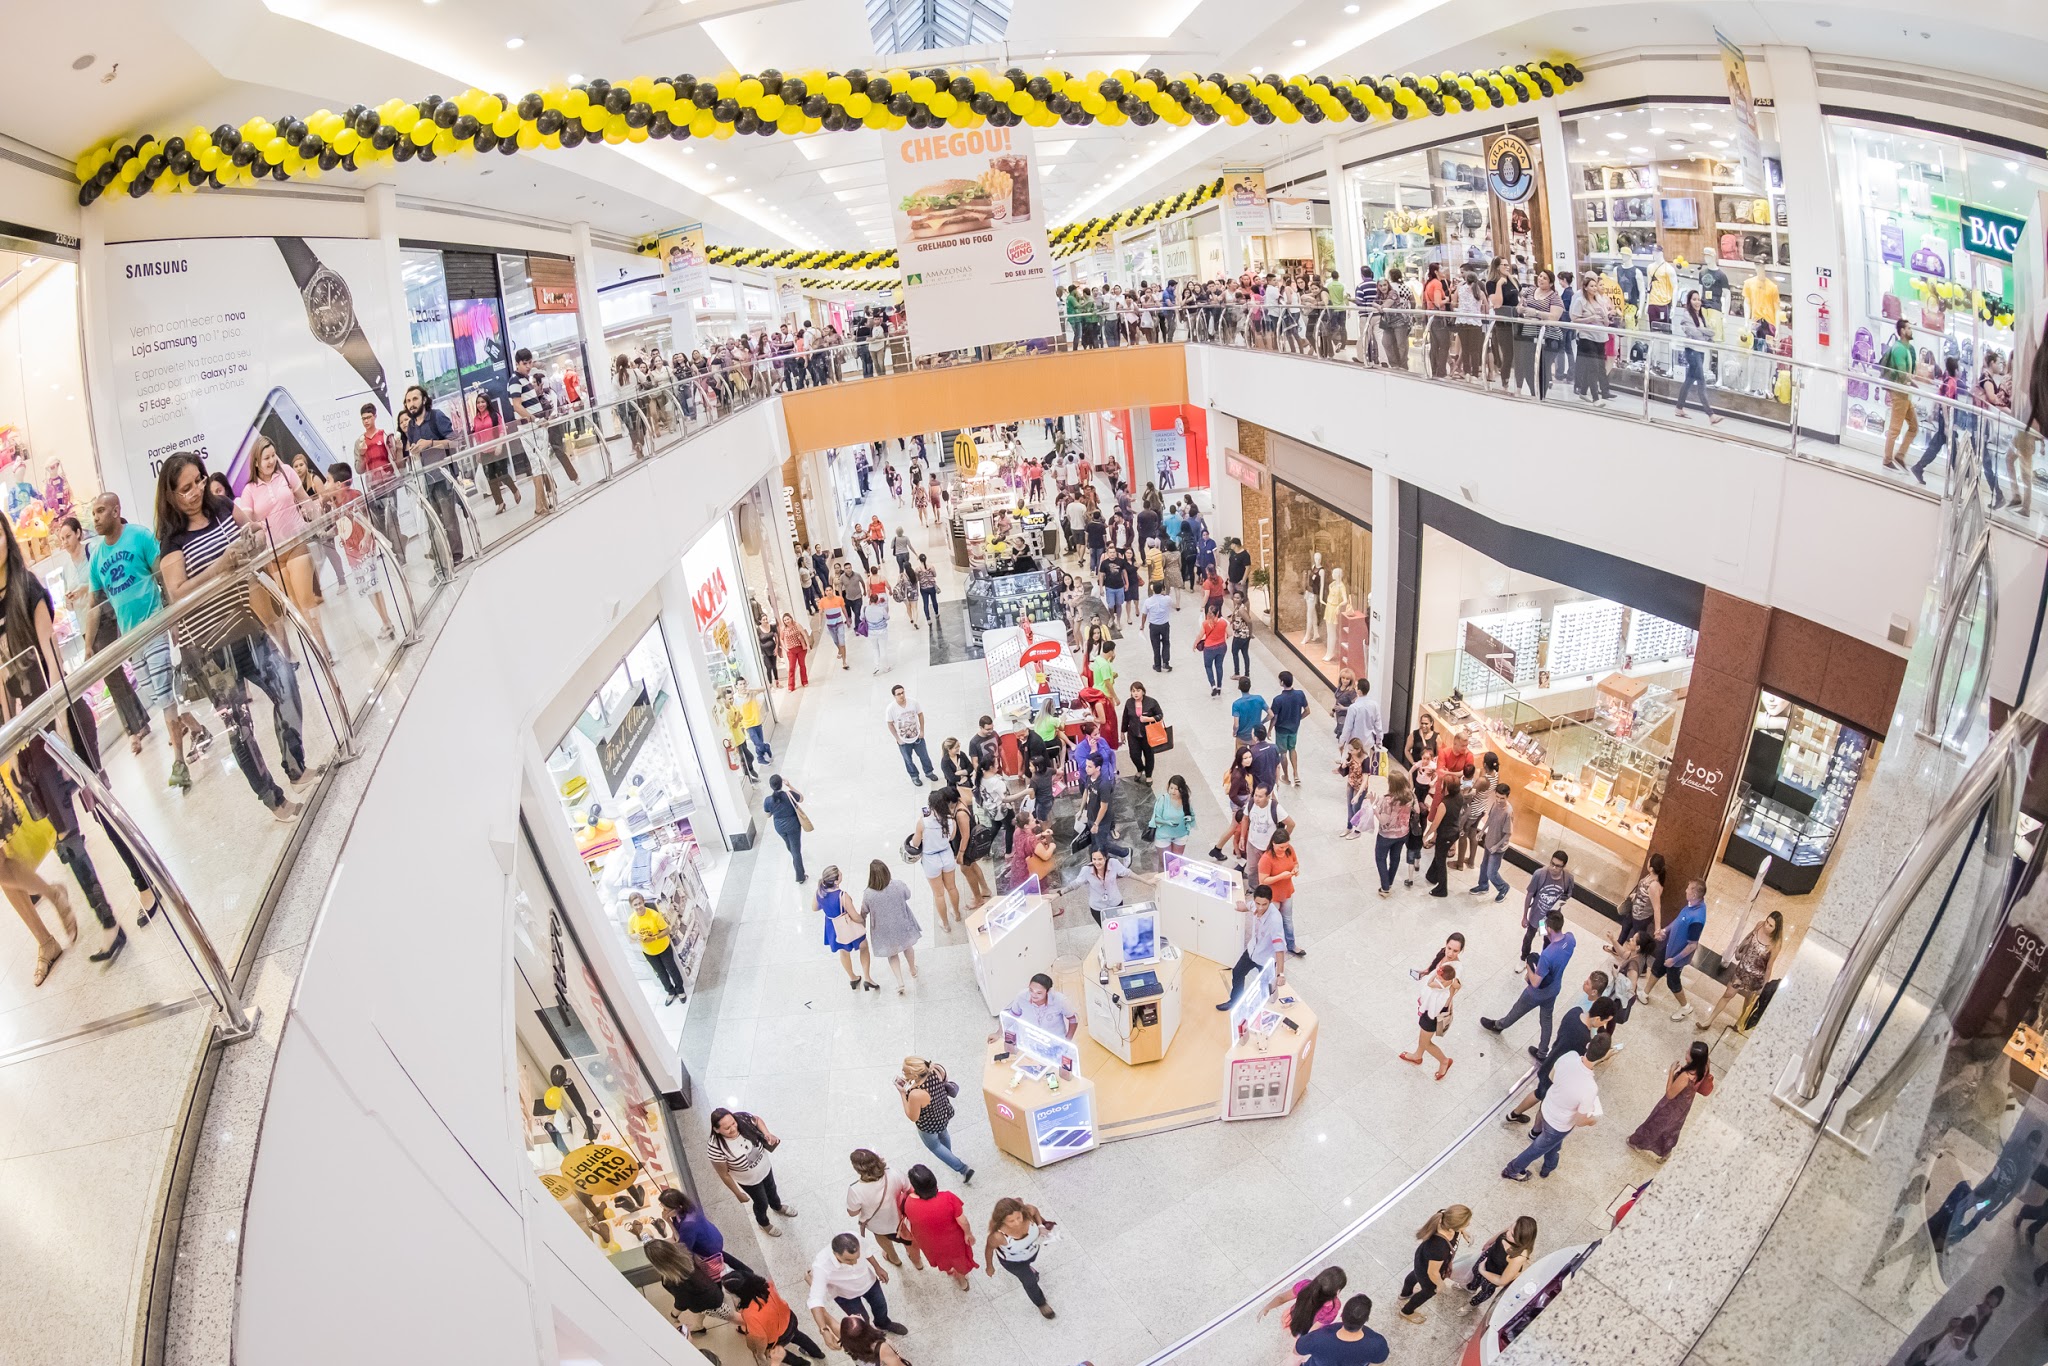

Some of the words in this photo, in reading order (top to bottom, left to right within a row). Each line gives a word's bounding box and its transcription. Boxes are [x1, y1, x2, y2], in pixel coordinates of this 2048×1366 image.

[901, 128, 1012, 163] CHEGOU!
[1491, 140, 1526, 166] GRANADA
[917, 239, 957, 252] GRELHADO
[960, 237, 970, 246] NO
[973, 234, 993, 244] FOGO
[1009, 241, 1031, 254] BURGER
[1010, 246, 1033, 261] KING
[126, 259, 188, 279] SAMSUNG
[925, 266, 973, 279] AMAZONAS
[1015, 269, 1027, 277] SEU
[1028, 267, 1044, 275] JEITO
[130, 324, 164, 338] Venha
[166, 314, 214, 331] conhecer
[217, 314, 223, 323] a
[224, 311, 246, 322] nova
[131, 343, 152, 358] Loja
[154, 335, 198, 352] Samsung
[199, 333, 212, 343] no
[135, 371, 140, 381] E
[142, 362, 187, 381] aproveite!
[187, 360, 200, 370] Na
[200, 354, 224, 366] troca
[225, 350, 236, 361] do
[237, 348, 252, 358] seu
[137, 381, 166, 397] usado
[167, 378, 183, 390] por
[184, 375, 200, 384] um
[200, 367, 228, 380] Galaxy
[228, 364, 237, 374] S7
[238, 363, 248, 371] ou
[139, 401, 148, 412] S7
[175, 387, 202, 406] ganhe
[204, 384, 219, 398] um
[147, 441, 178, 459] Parcele
[178, 438, 192, 448] em
[100, 550, 135, 576] HOLLISTER
[110, 564, 126, 583] 22
[1517, 600, 1537, 608] GUCCI
[1686, 759, 1717, 785] top
[1037, 1106, 1062, 1121] moto
[565, 1146, 614, 1180] Liquida
[574, 1156, 626, 1191] Ponto
[605, 1164, 638, 1187] Mix
